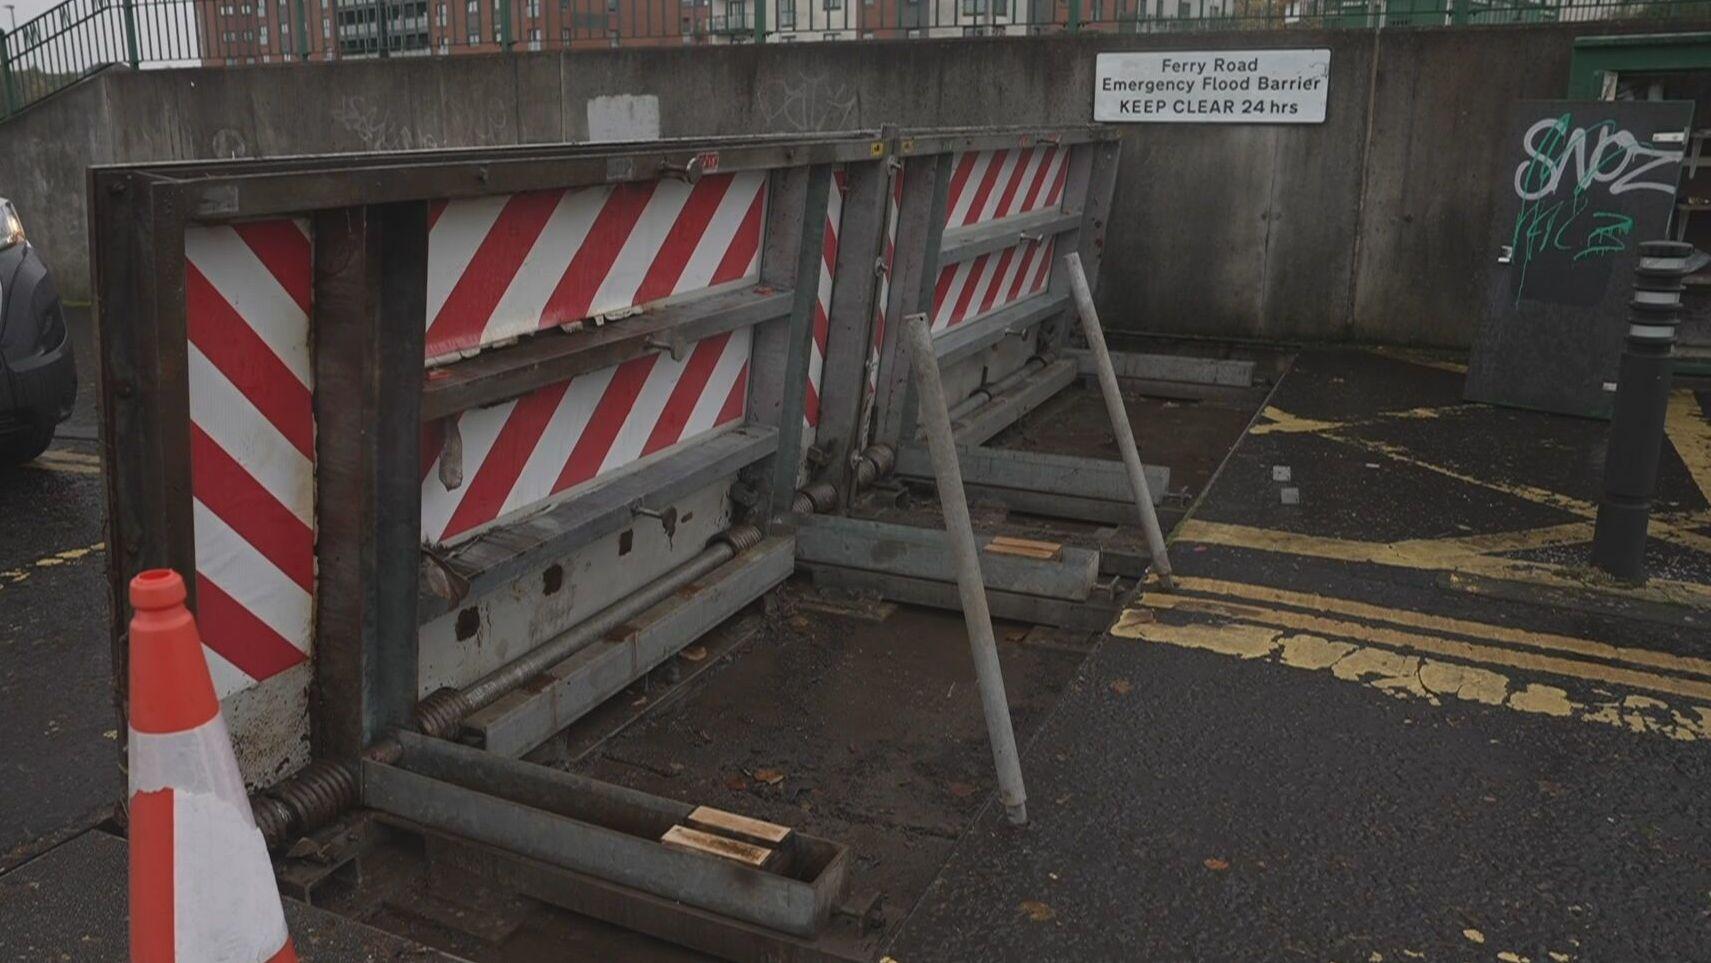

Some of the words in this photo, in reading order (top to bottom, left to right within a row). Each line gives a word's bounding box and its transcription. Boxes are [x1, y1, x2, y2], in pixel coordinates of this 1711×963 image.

[1161, 58, 1206, 75] Ferry
[1213, 57, 1258, 73] Road
[1102, 77, 1195, 94] Emergency
[1202, 76, 1250, 91] Flood
[1258, 76, 1321, 91] Barrier
[1119, 100, 1166, 114] KEEP
[1173, 100, 1234, 114] CLEAR
[1241, 99, 1265, 114] 24
[1270, 99, 1299, 115] hrs
